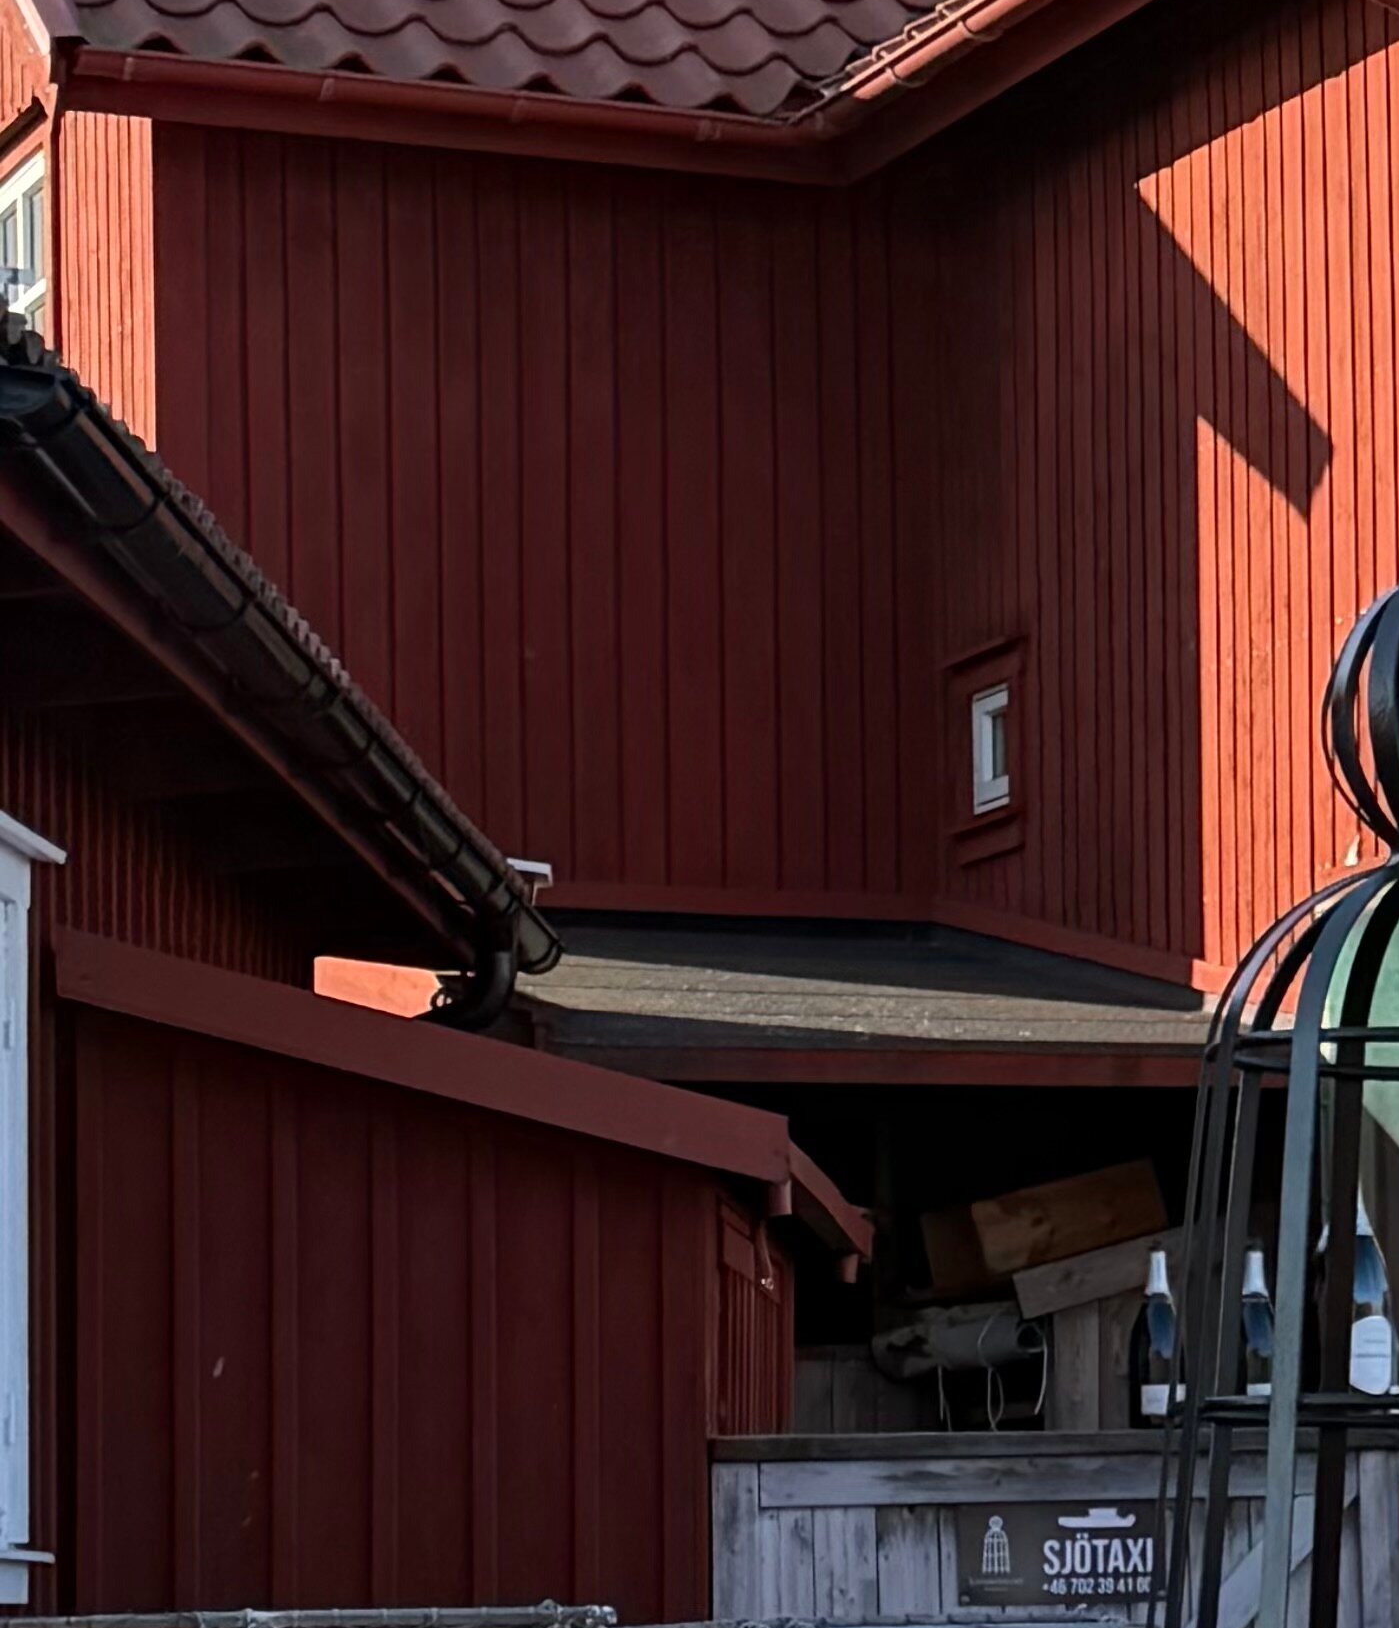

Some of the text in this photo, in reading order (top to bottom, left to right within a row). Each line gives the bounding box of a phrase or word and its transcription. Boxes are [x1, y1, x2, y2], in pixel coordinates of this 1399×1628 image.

[1042, 1532, 1154, 1576] SJÖTAXI
[1070, 1577, 1094, 1595] 702
[1097, 1577, 1115, 1594] 39
[1116, 1576, 1133, 1593] 41
